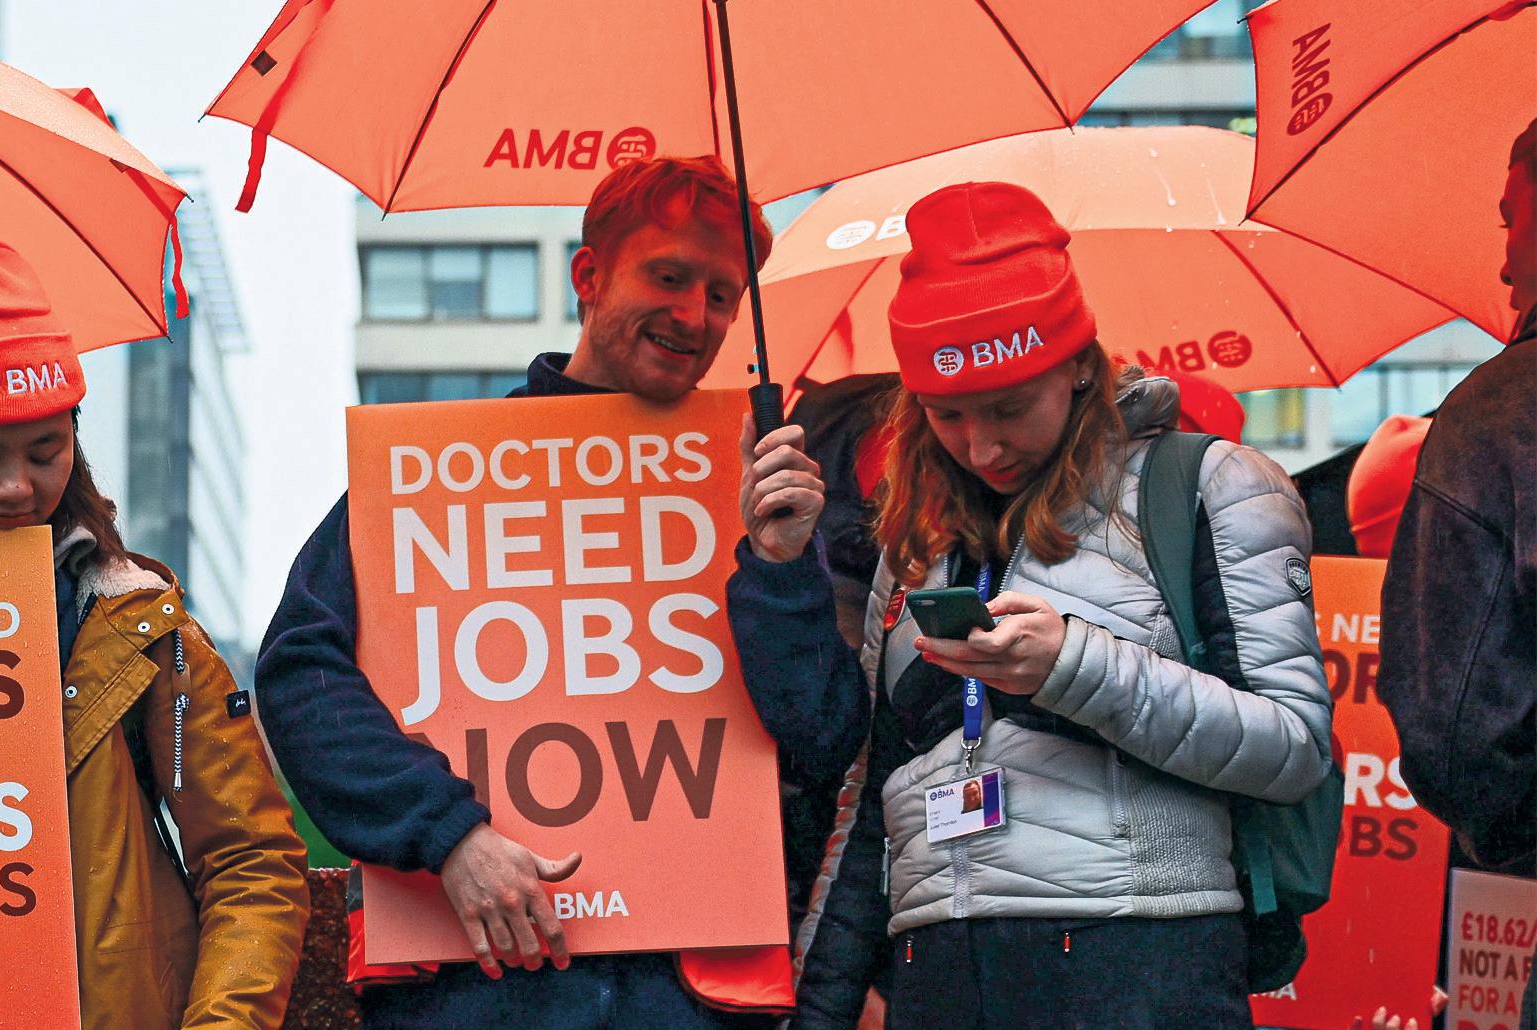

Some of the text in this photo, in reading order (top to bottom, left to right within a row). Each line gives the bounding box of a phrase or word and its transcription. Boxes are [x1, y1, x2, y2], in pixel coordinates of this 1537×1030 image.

[973, 326, 1045, 368] BMA
[6, 361, 69, 396] BMA
[389, 432, 712, 495] DOCTORS
[393, 495, 717, 594] NEED
[1331, 613, 1380, 645] NE
[401, 593, 725, 726] JOBS
[967, 677, 978, 695] BM
[938, 788, 955, 799] BMA
[1349, 815, 1419, 861] BS
[554, 890, 630, 920] BMA
[1459, 948, 1502, 979] NOT
[1504, 955, 1519, 982] A
[1458, 984, 1519, 1017] FOR A
